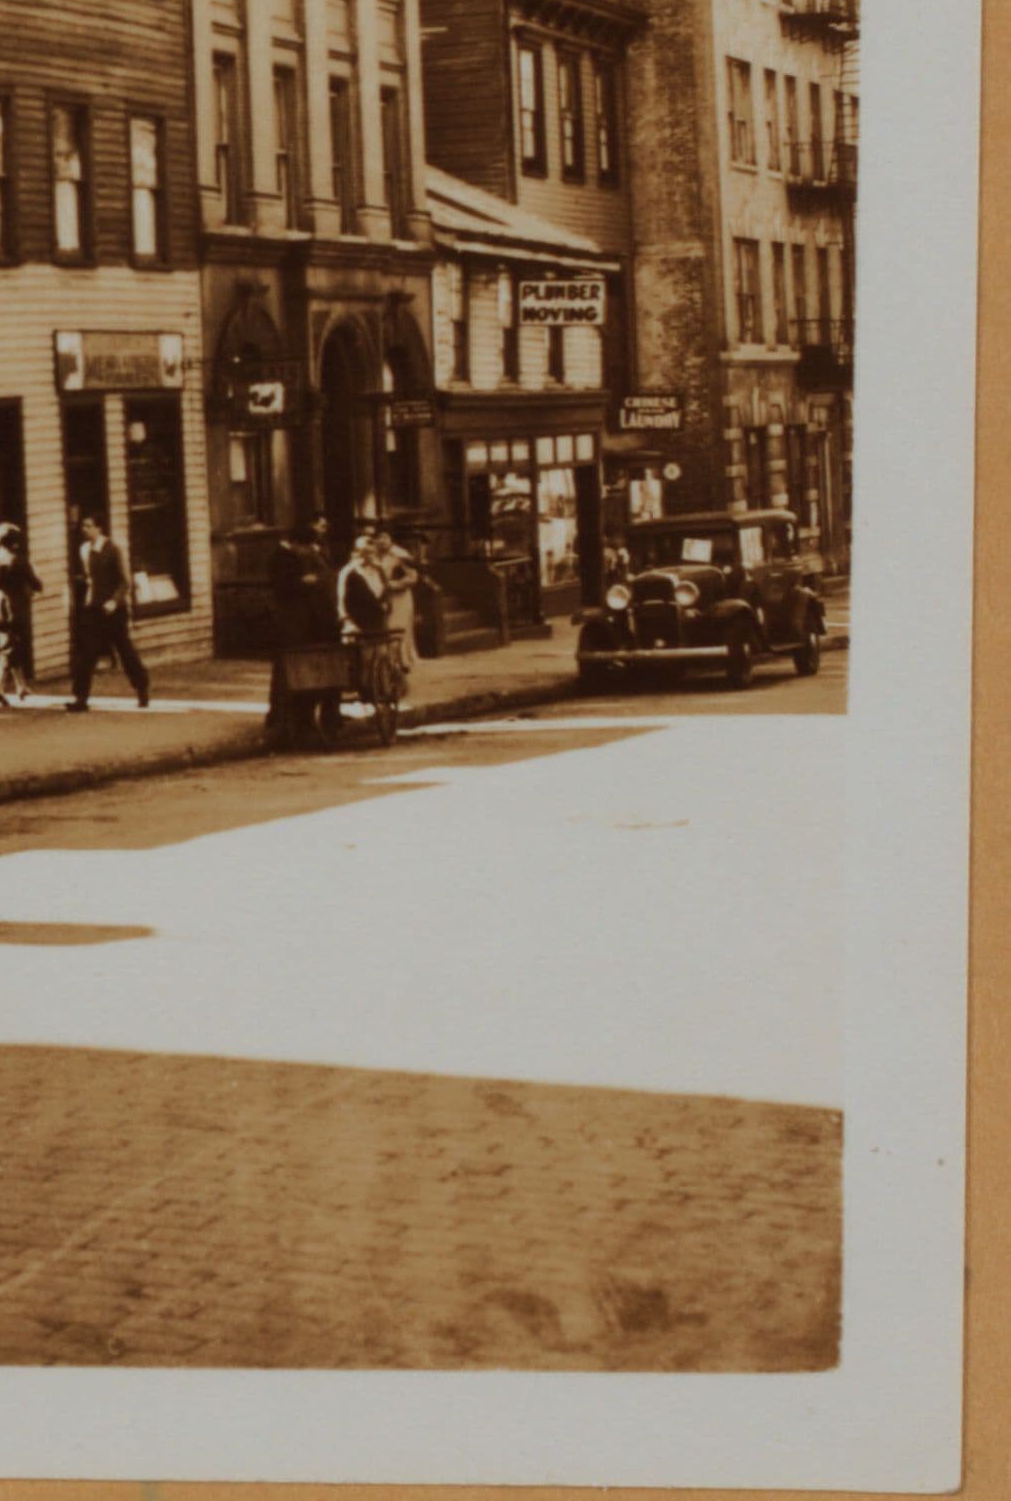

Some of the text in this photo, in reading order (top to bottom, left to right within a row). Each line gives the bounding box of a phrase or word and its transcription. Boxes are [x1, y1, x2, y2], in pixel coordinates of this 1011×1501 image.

[521, 284, 600, 300] PLUMBER
[521, 306, 597, 322] MOVING
[624, 396, 677, 408] CHINESE
[619, 408, 682, 429] LAUNDRY
